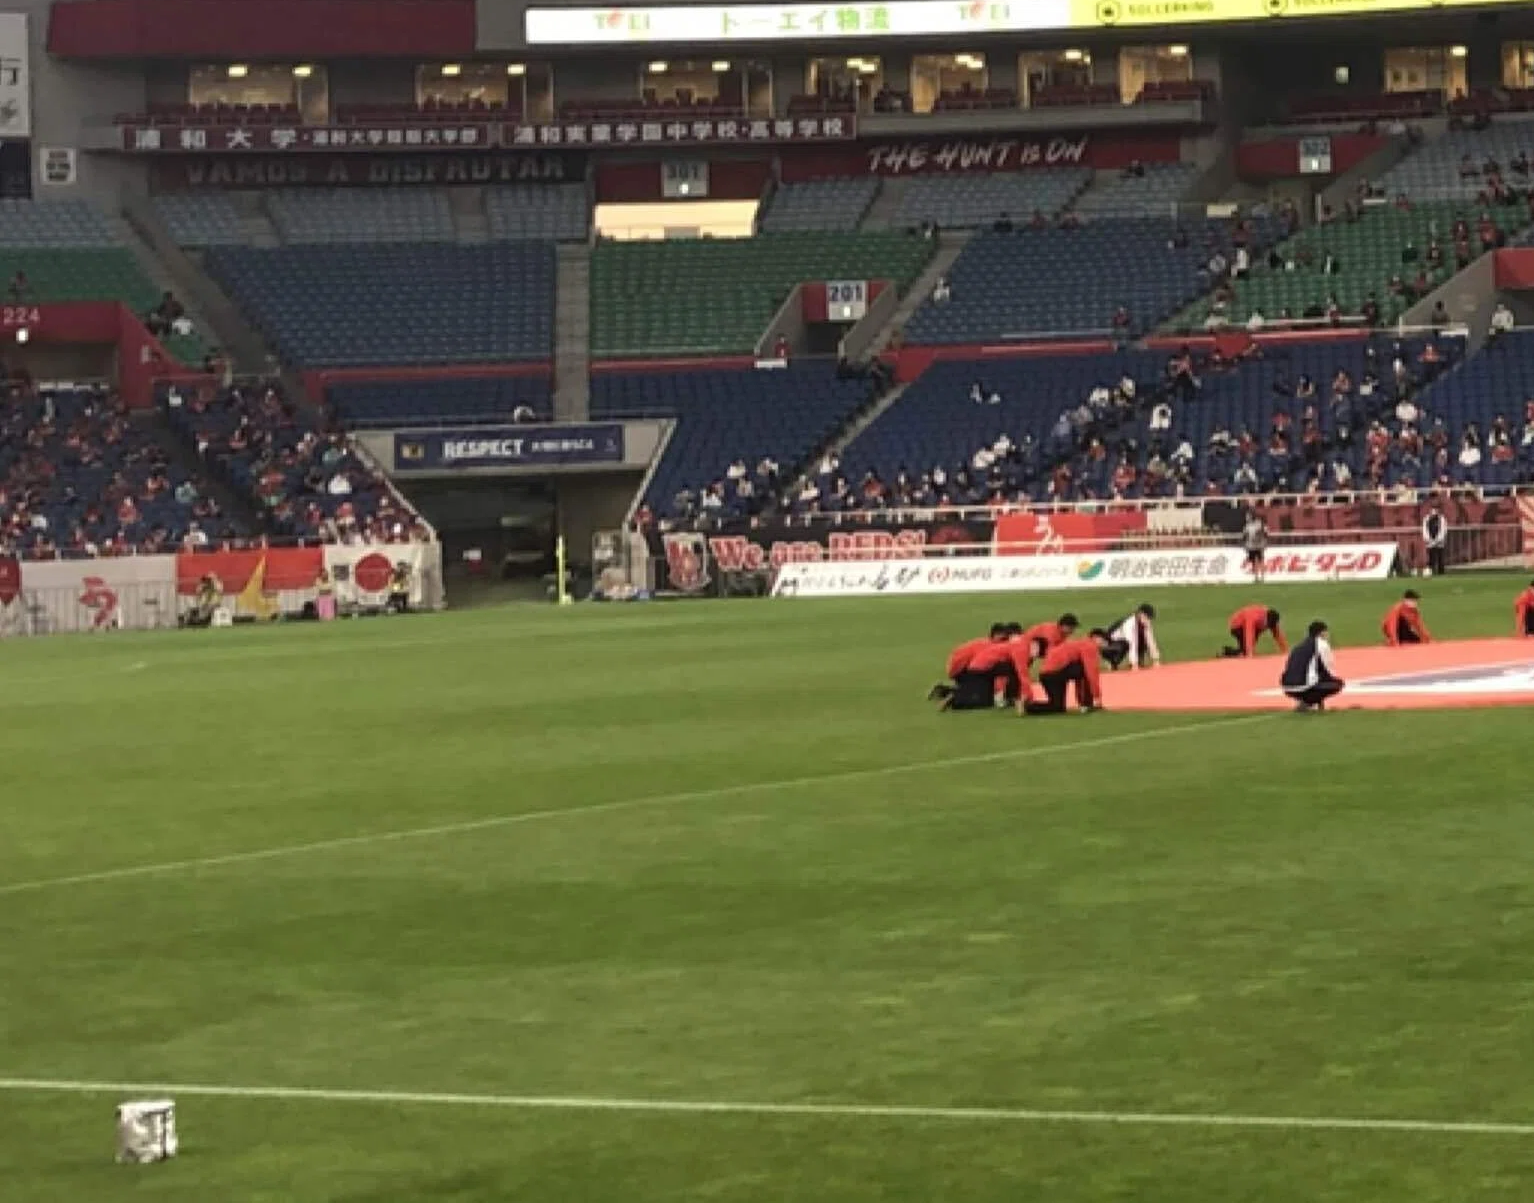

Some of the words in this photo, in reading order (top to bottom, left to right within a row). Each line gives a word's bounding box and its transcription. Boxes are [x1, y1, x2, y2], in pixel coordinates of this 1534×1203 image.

[868, 145, 928, 173] THE
[935, 141, 1018, 171] HUNT
[1045, 135, 1088, 163] ON
[829, 283, 863, 302] 201
[3, 307, 40, 325] 224
[443, 438, 523, 459] RESPECT
[709, 535, 764, 571] We
